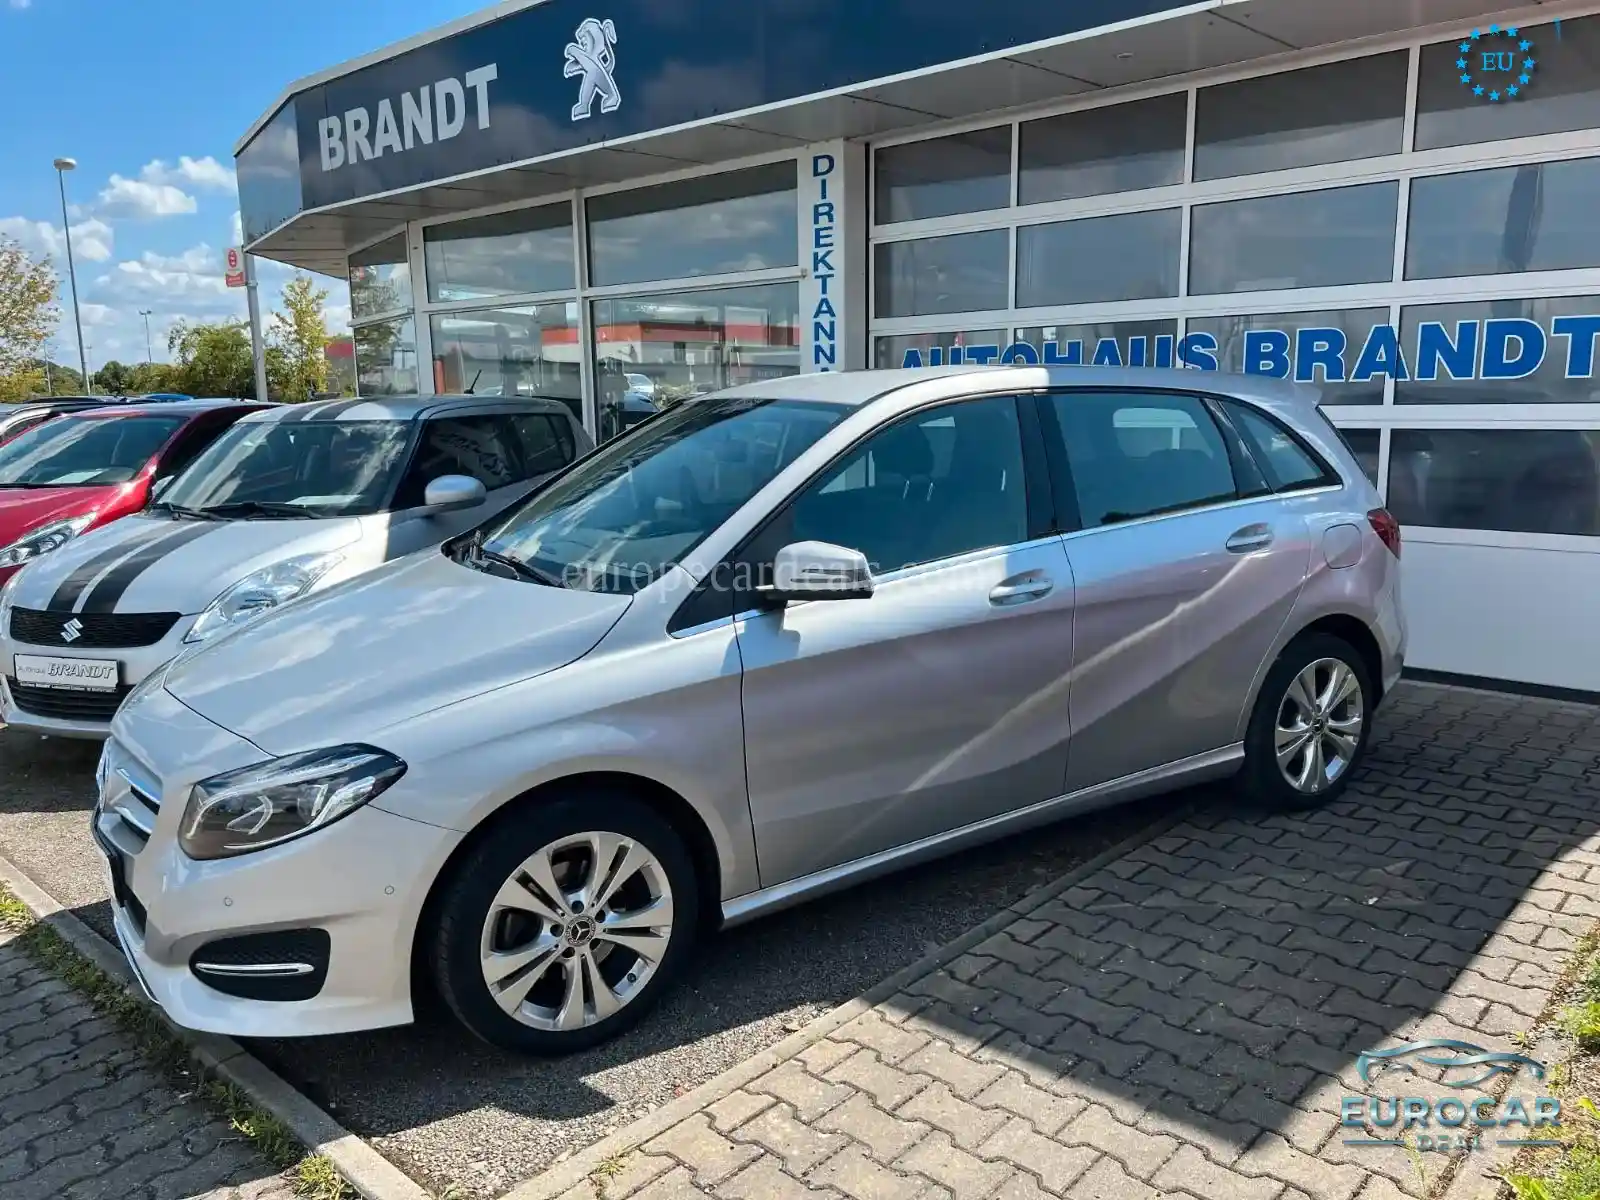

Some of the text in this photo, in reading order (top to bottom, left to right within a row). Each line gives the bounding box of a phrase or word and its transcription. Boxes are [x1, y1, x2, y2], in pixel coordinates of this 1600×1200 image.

[318, 63, 498, 172] BRANDT
[813, 155, 836, 372] DIREKTANN
[1243, 316, 1600, 382] BRANDT
[48, 663, 115, 679] BRANDT
